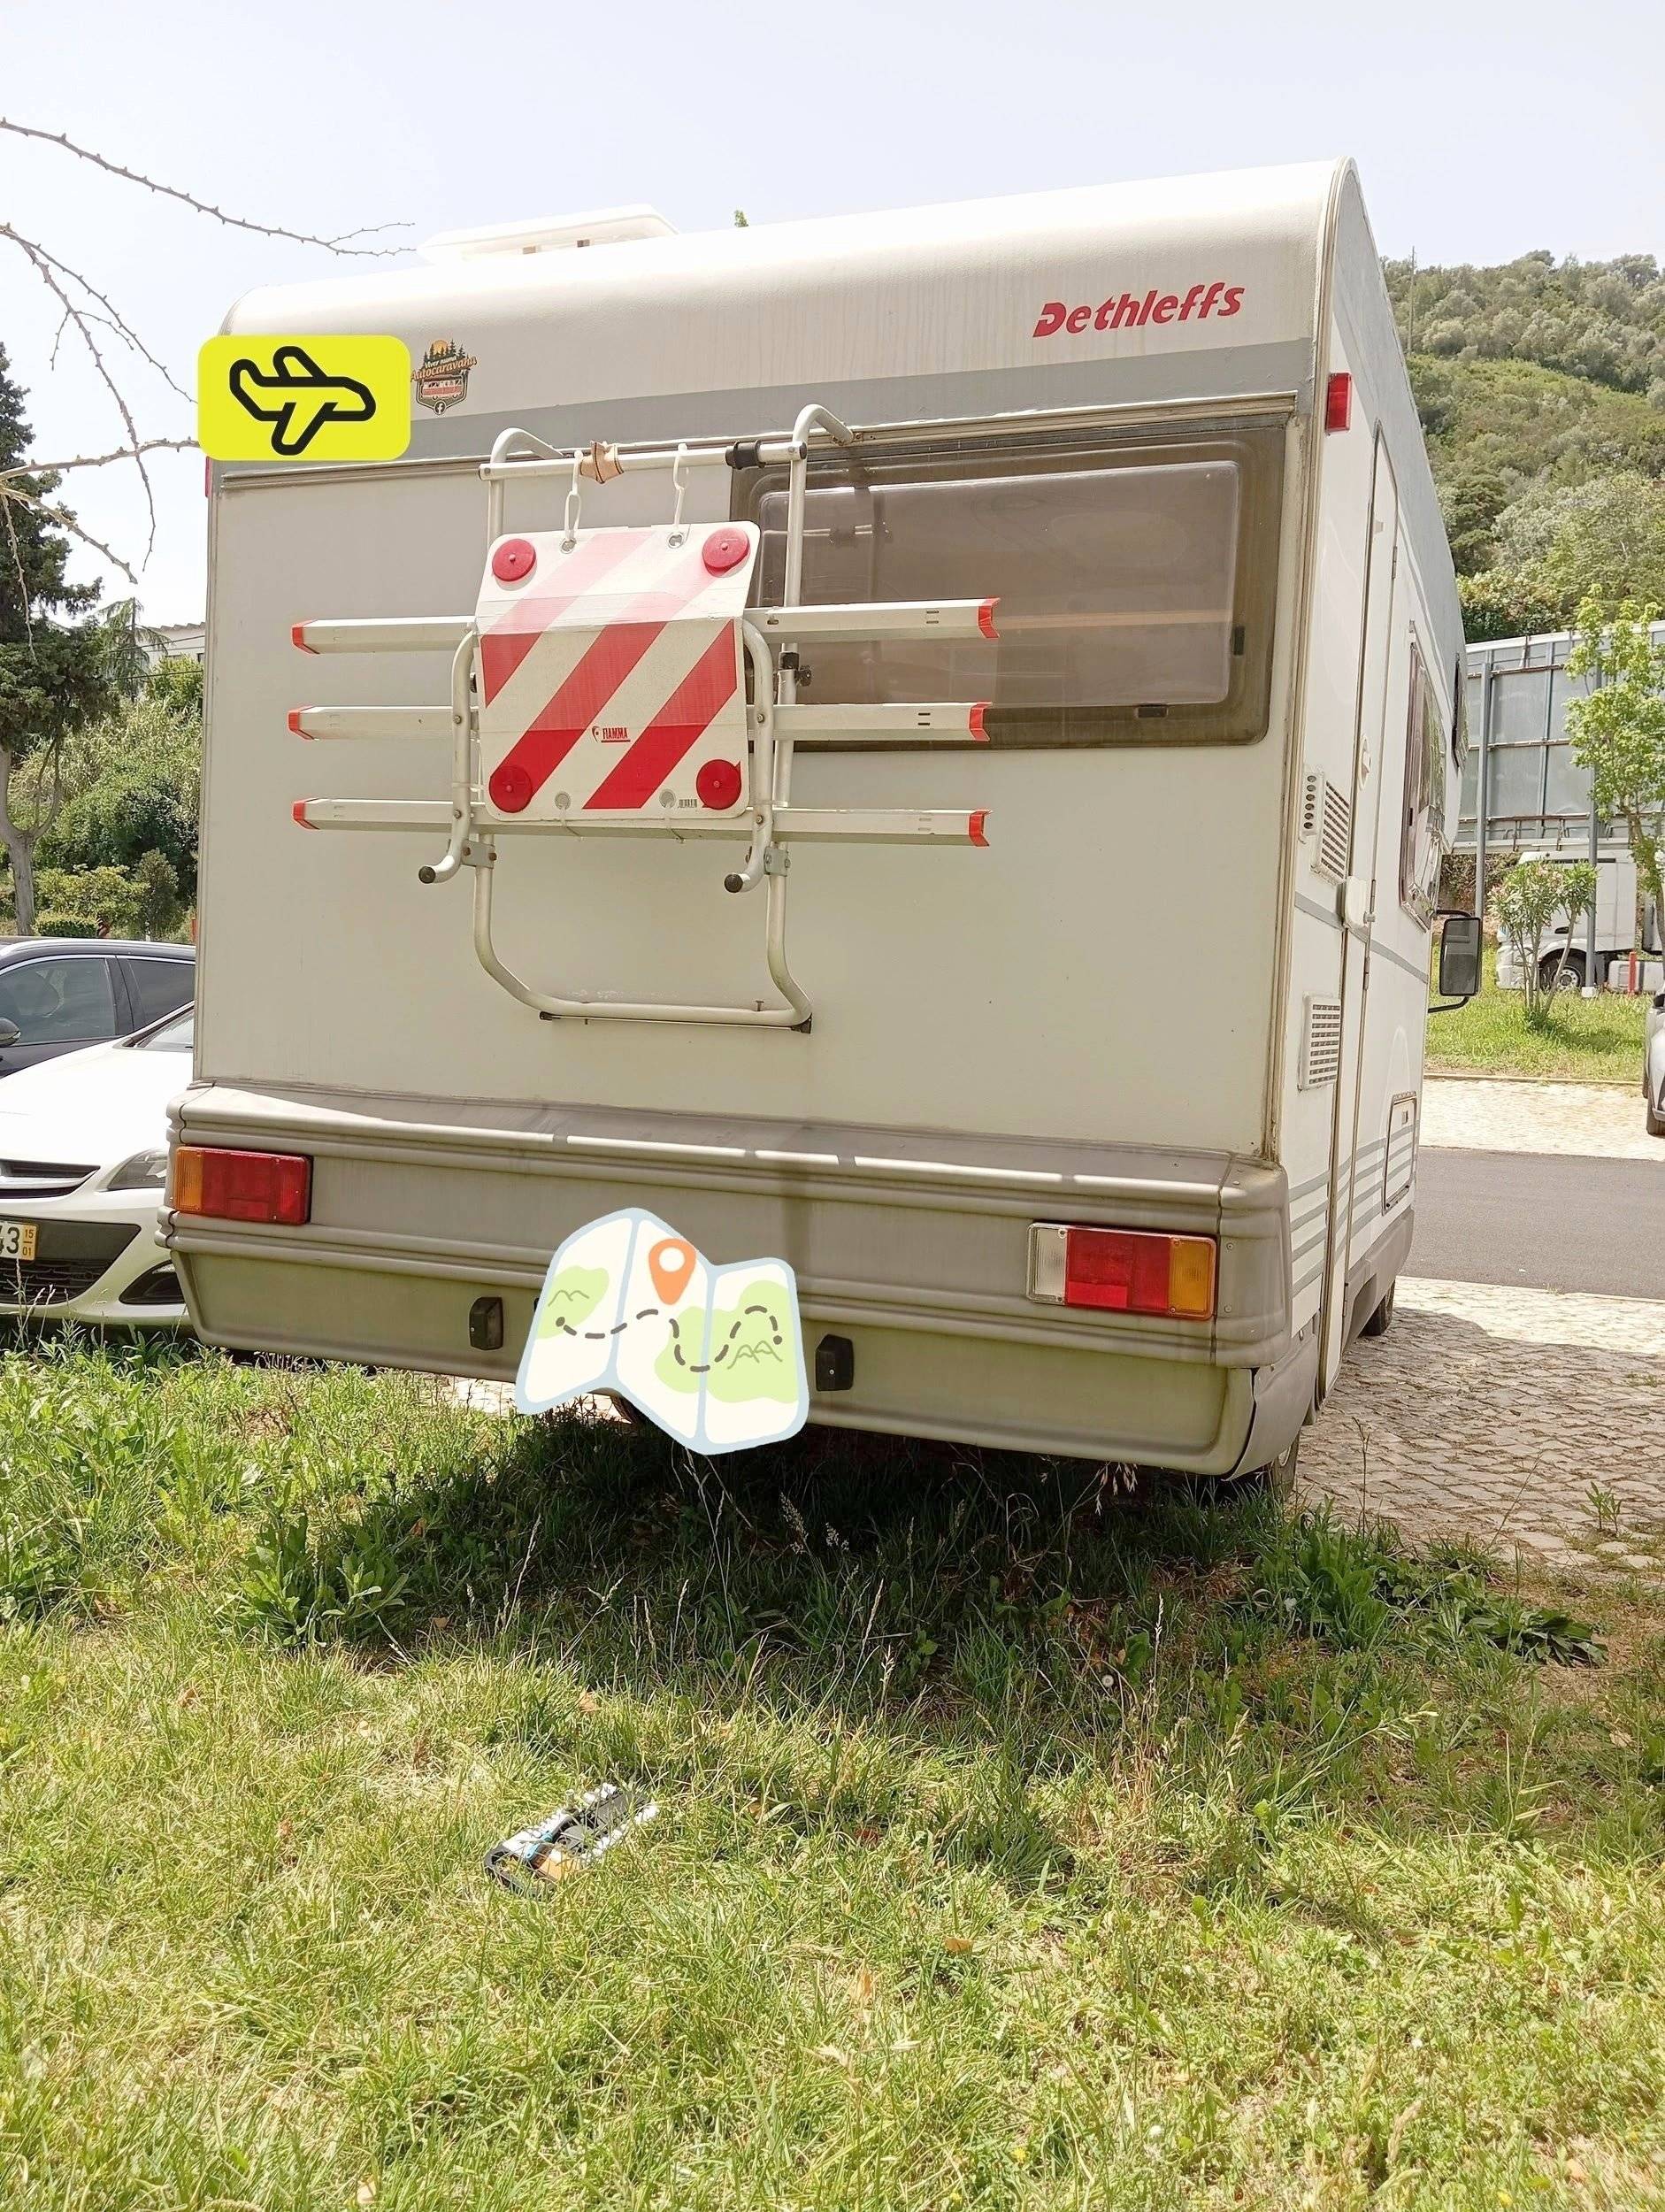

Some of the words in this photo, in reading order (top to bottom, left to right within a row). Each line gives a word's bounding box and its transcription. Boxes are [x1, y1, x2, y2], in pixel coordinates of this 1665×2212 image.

[1032, 281, 1246, 338] Dethleffs
[602, 727, 628, 739] FIAMMA
[25, 1229, 35, 1239] 15
[22, 1247, 32, 1256] 01
